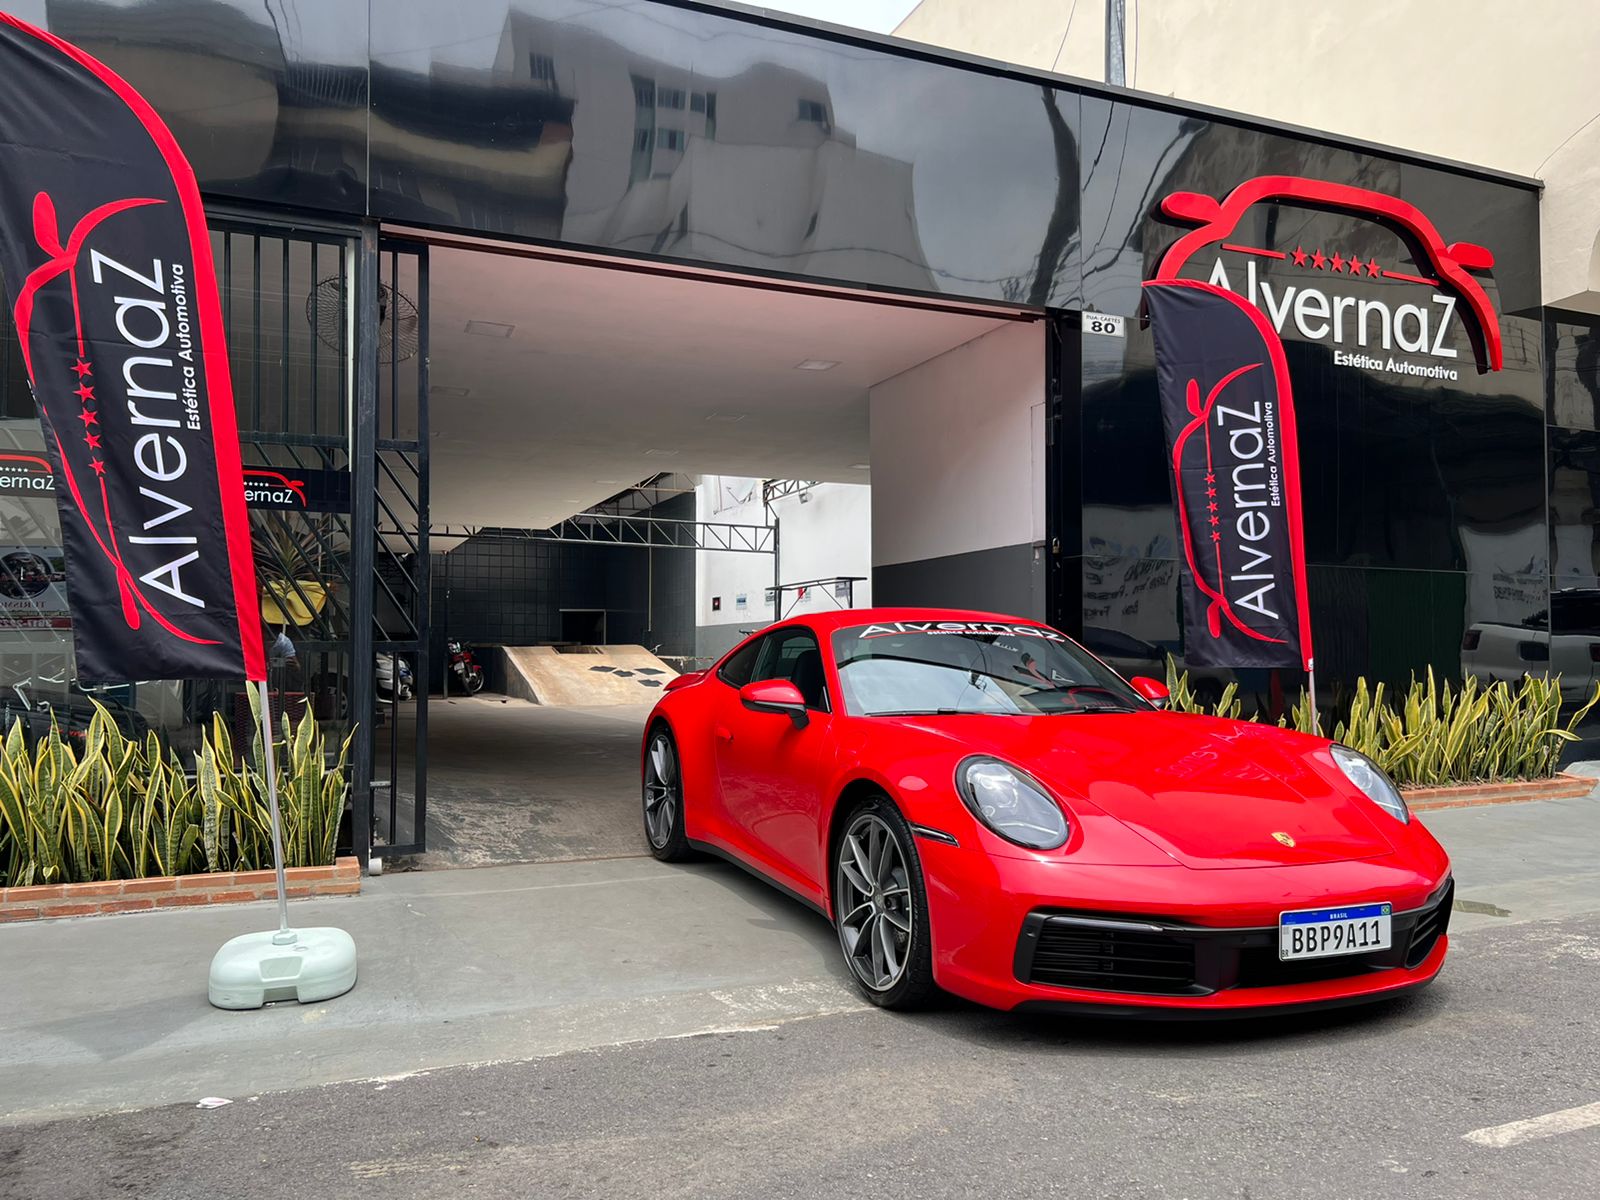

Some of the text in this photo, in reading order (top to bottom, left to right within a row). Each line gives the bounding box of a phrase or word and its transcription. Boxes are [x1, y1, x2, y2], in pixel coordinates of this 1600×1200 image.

[1091, 321, 1116, 334] 80
[171, 263, 201, 431] Estética Automotiva
[1333, 350, 1458, 381] Estética Automotiva
[1264, 401, 1281, 507] Estética Automotiva
[1329, 912, 1348, 920] BRASIL
[1291, 920, 1381, 954] BBP9A11
